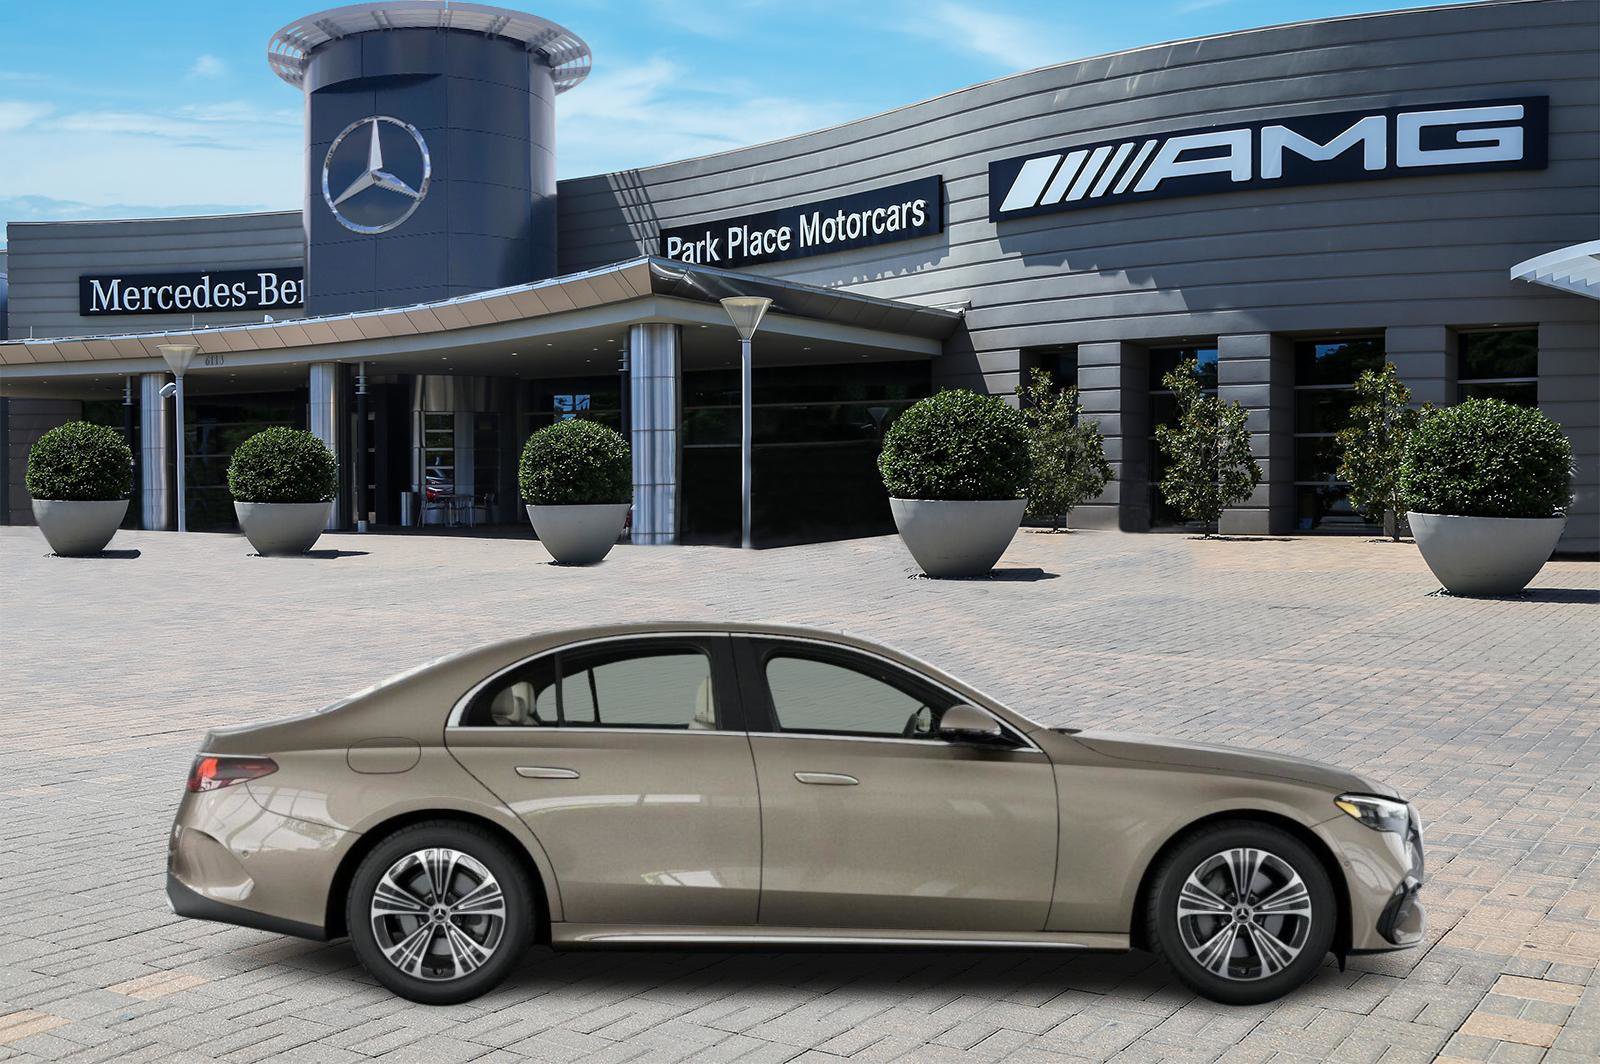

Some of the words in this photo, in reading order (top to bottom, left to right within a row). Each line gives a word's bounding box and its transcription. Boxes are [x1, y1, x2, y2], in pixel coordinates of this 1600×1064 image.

[1133, 105, 1524, 192] AMG
[667, 231, 720, 264] Park
[728, 225, 791, 259] Place
[800, 199, 927, 248] Motorcars
